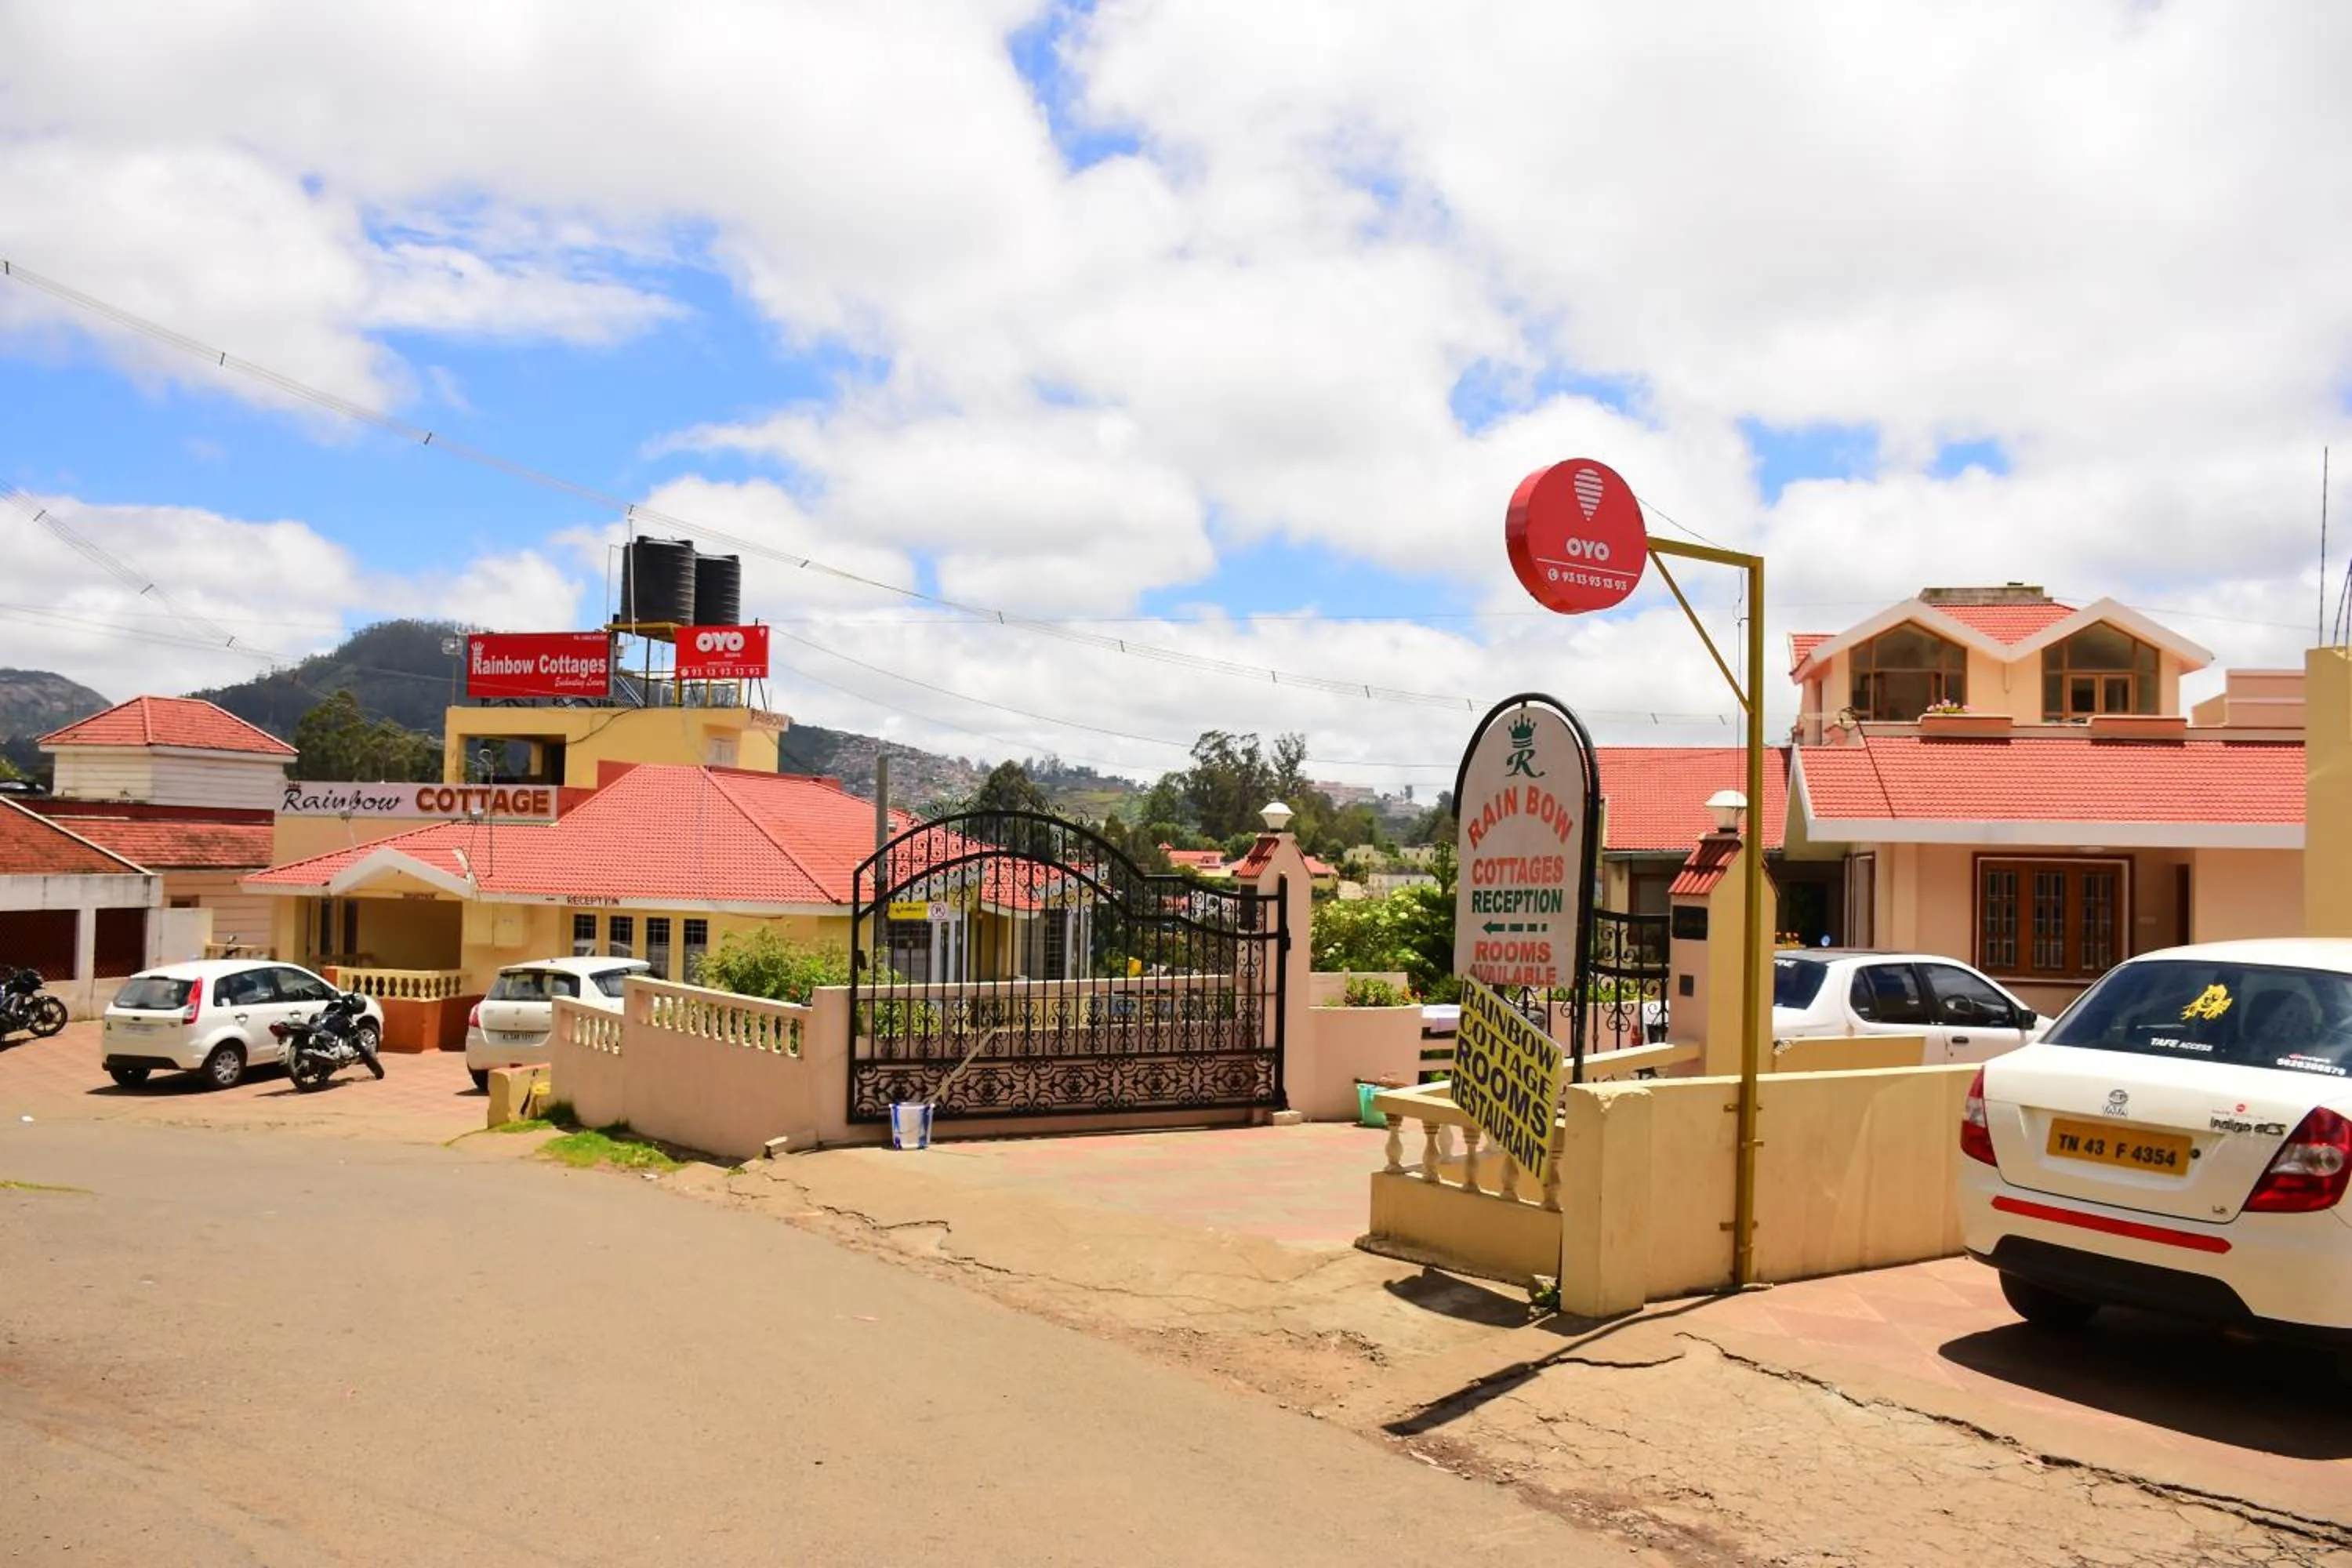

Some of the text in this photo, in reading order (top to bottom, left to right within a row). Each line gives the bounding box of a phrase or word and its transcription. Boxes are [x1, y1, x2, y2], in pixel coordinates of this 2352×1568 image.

[1566, 536, 1610, 561] OYO
[695, 631, 745, 652] OYO
[472, 654, 606, 678] Rainbow Cottages
[1505, 749, 1545, 779] R
[281, 786, 551, 815] Rainbow COTTAGE
[1468, 785, 1574, 851] RAIN BOW
[1472, 855, 1565, 885] COTTAGES
[1471, 888, 1564, 914] RECEPTION
[1474, 939, 1552, 964] ROOMS
[1469, 964, 1556, 985] AVAILABLE
[1462, 978, 1557, 1074] RAINBOW
[1459, 1010, 1552, 1105] COTTAGE
[1455, 1034, 1548, 1139] ROOMS
[1450, 1067, 1547, 1178] RESTAURANT
[2102, 1105, 2129, 1117] TATA
[2210, 1116, 2286, 1135] Indigo eCS
[2059, 1134, 2177, 1167] TN 43 F 4354
